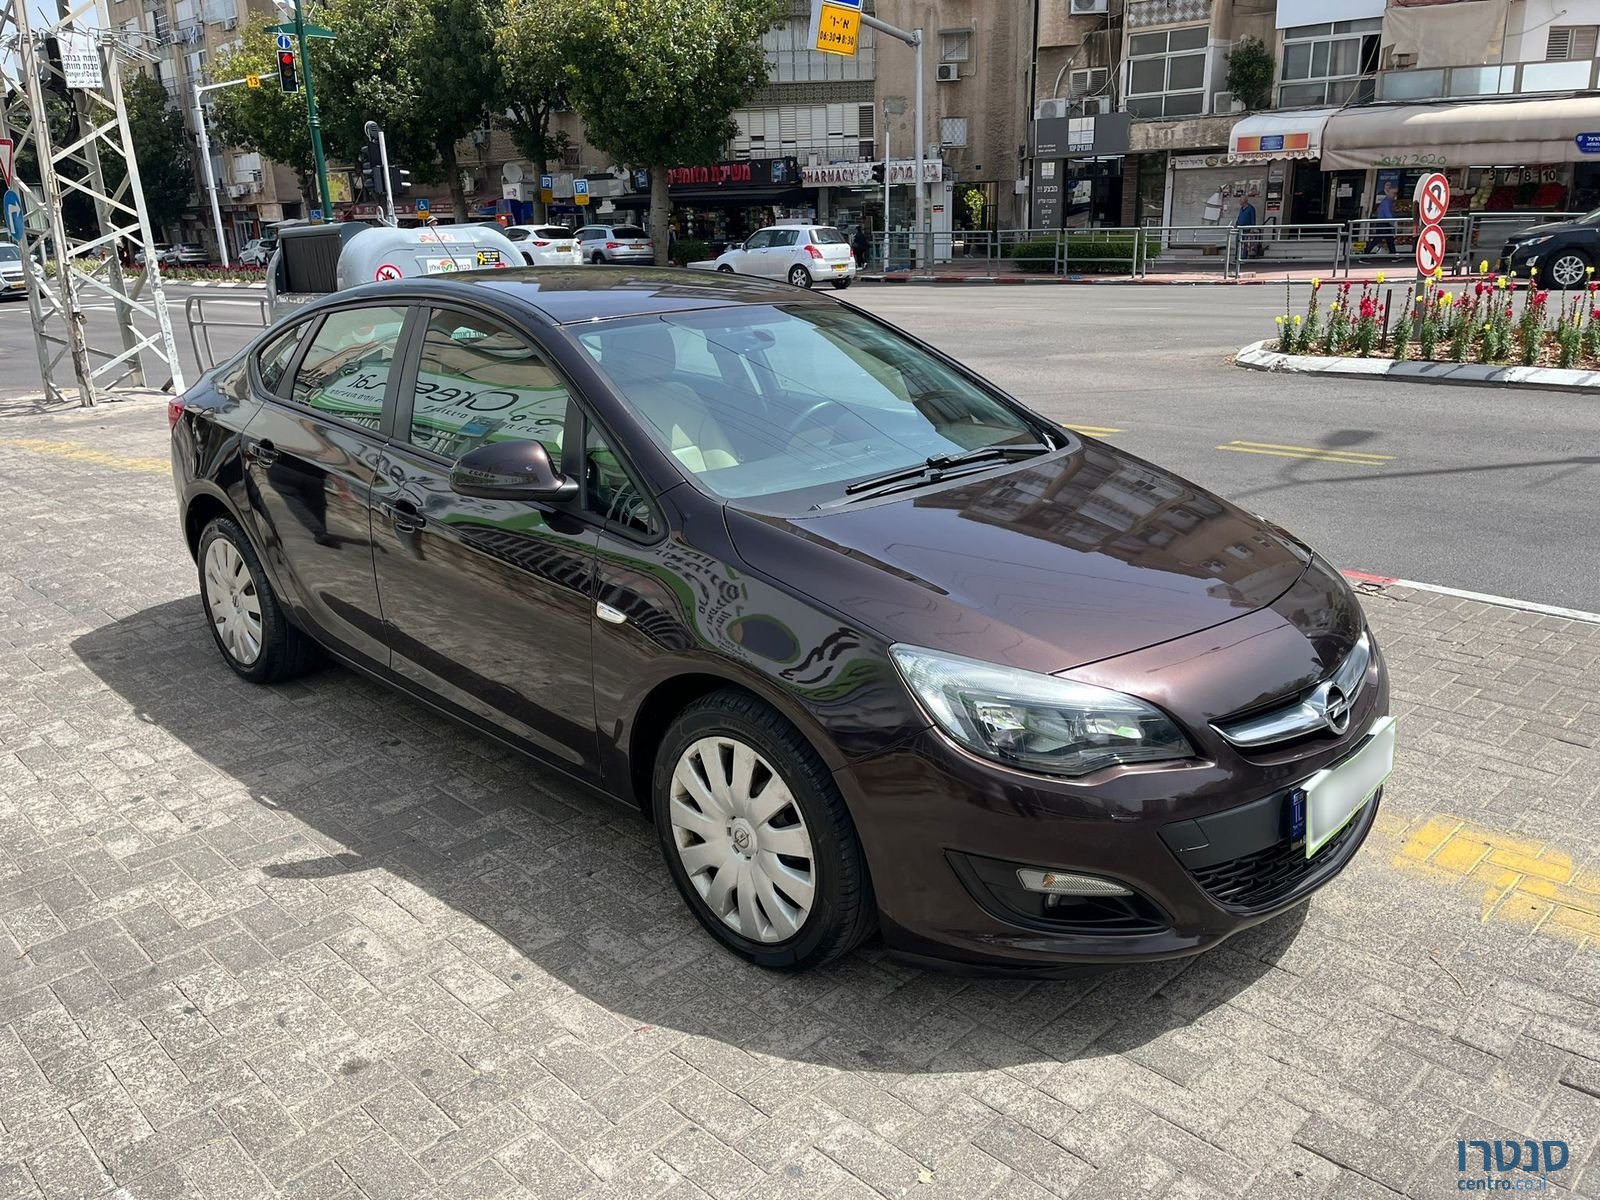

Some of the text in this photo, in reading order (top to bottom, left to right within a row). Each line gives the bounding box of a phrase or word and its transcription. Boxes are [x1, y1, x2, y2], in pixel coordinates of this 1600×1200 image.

[820, 31, 854, 45] 06:30 8:30
[249, 77, 258, 85] 13
[801, 166, 855, 184] PHARMACY
[1504, 170, 1512, 182] 7
[1543, 170, 1556, 180] 10
